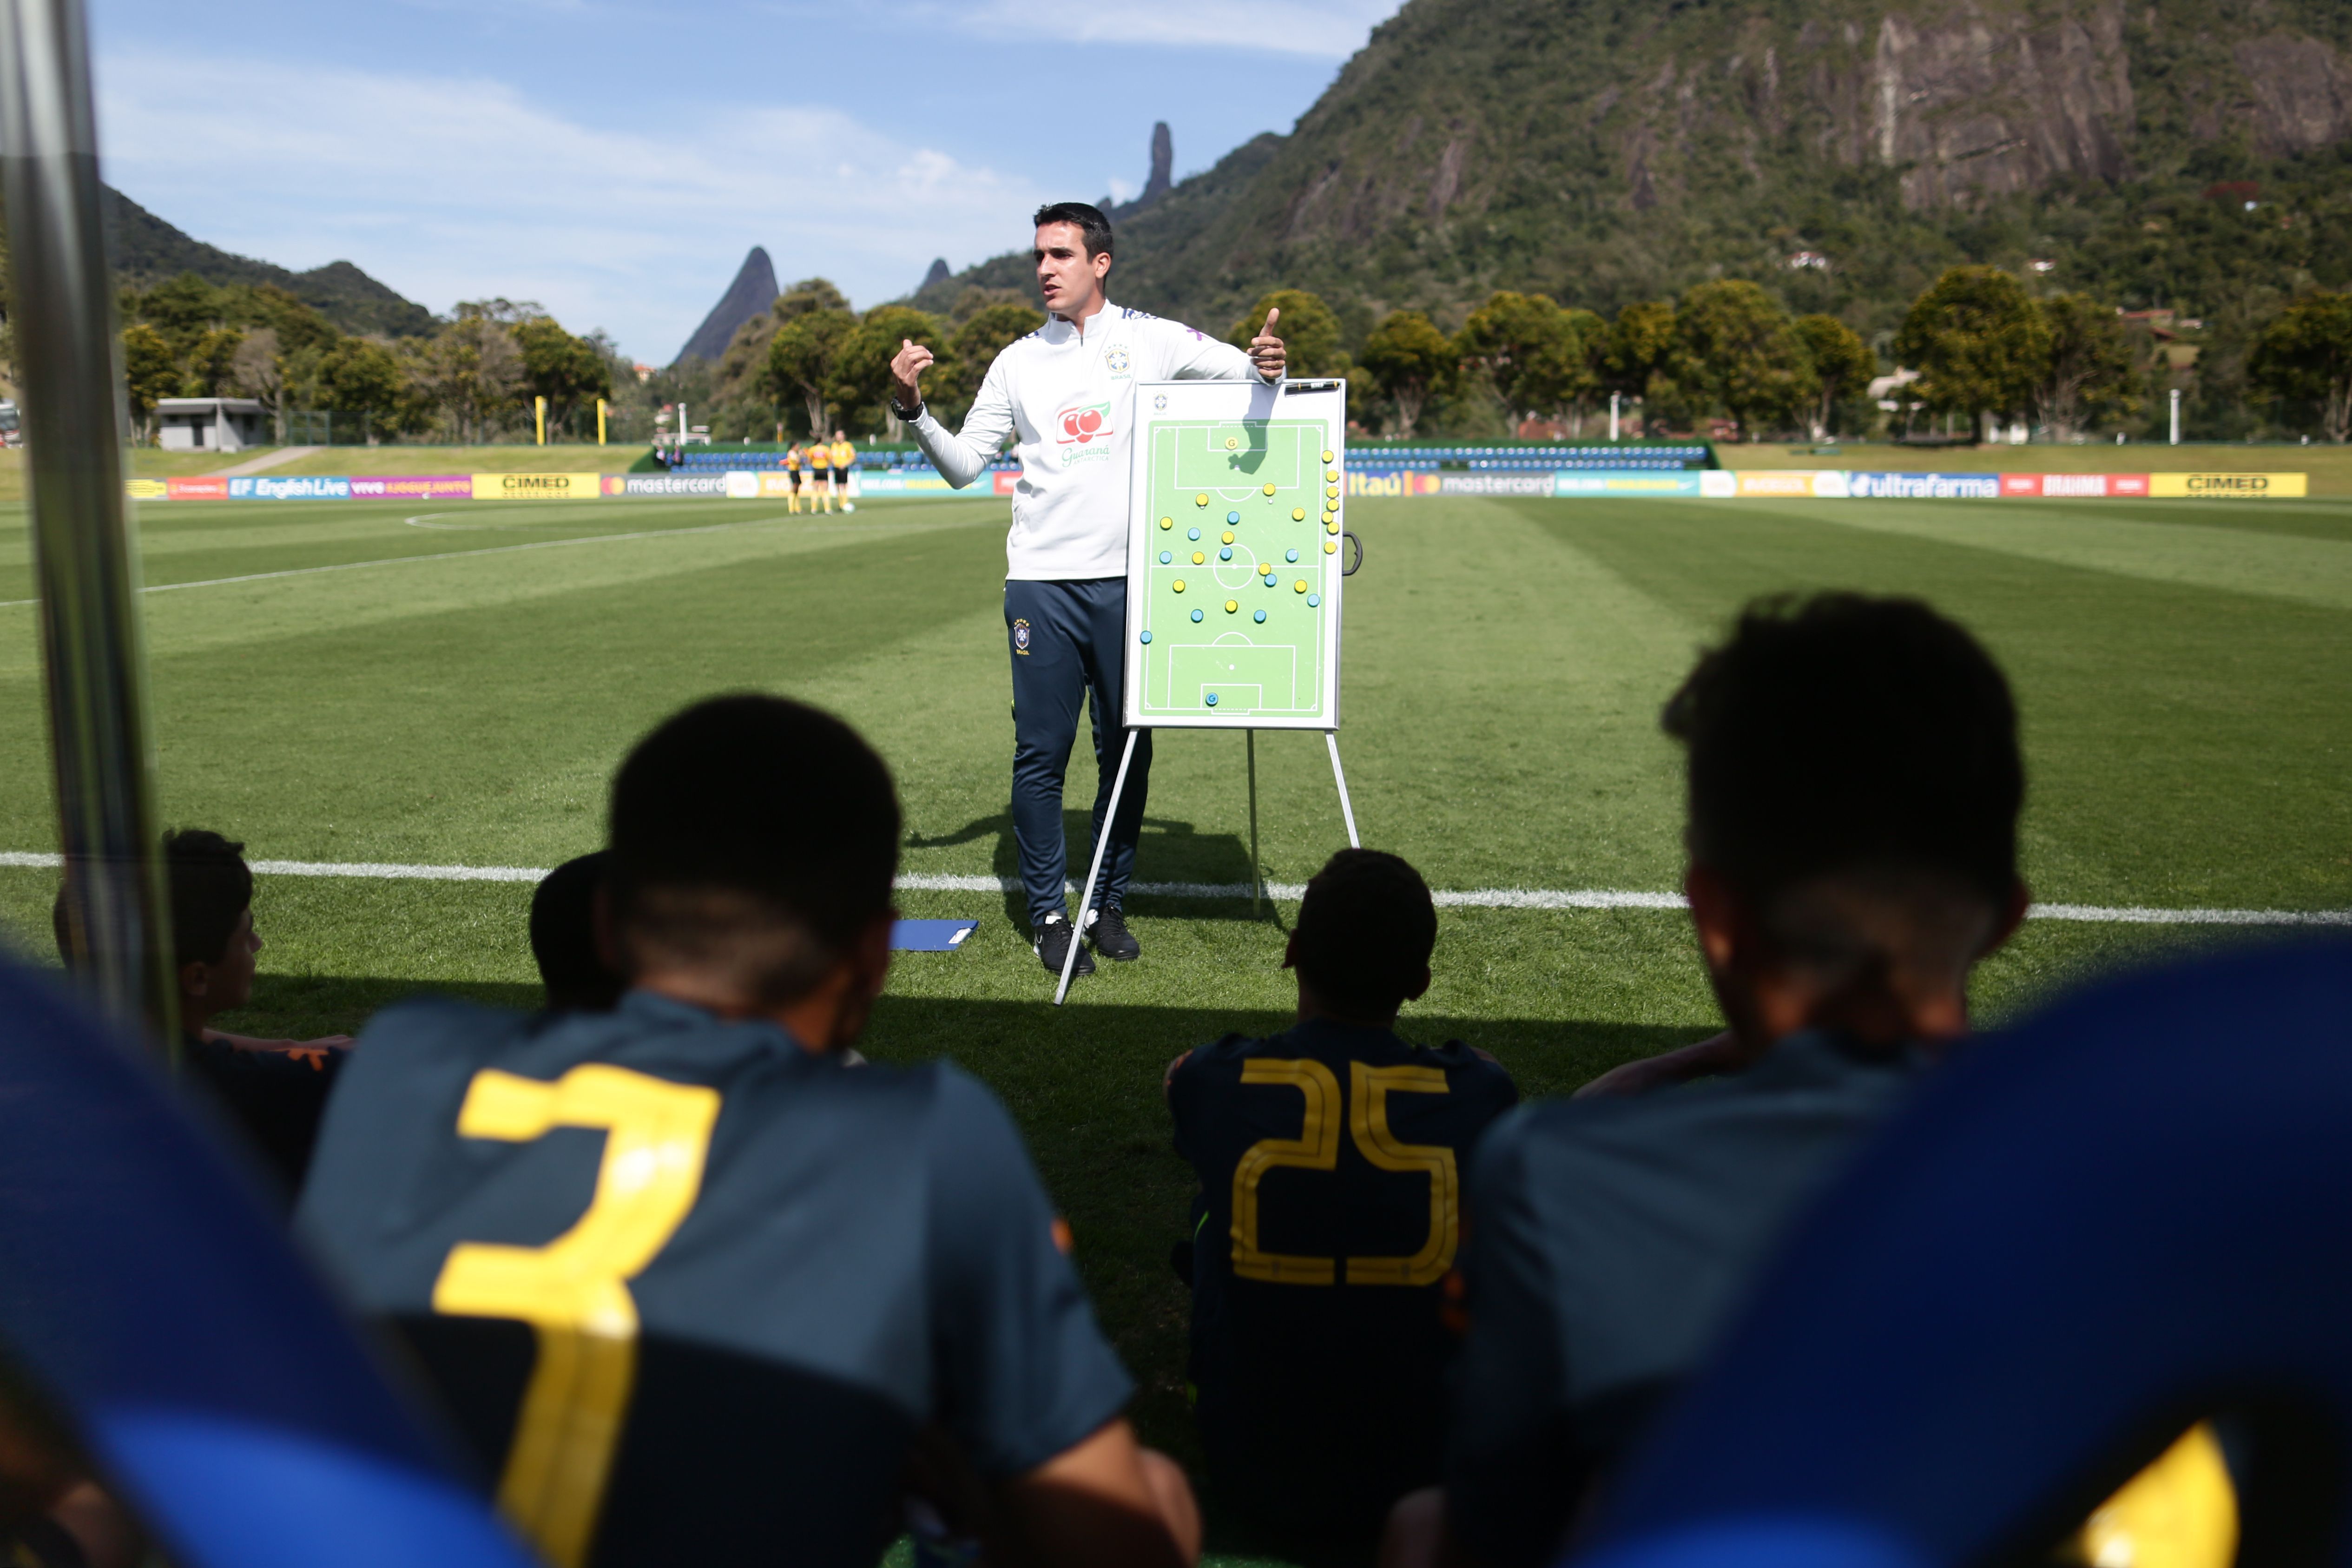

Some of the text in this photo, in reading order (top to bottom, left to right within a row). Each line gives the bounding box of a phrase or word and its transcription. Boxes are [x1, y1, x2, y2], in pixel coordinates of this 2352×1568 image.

[1062, 445, 1110, 468] Guaraná
[1074, 455, 1109, 465] ANTARCTICA
[230, 478, 349, 499] EF English Live
[503, 477, 569, 488] CIMED
[627, 475, 726, 493] mastercard
[1349, 471, 1401, 496] Itaú
[1443, 474, 1555, 493] mastercard
[1871, 473, 1998, 498] ultrafarma
[2187, 477, 2268, 489] CIMED
[1229, 1058, 1459, 1286] 25
